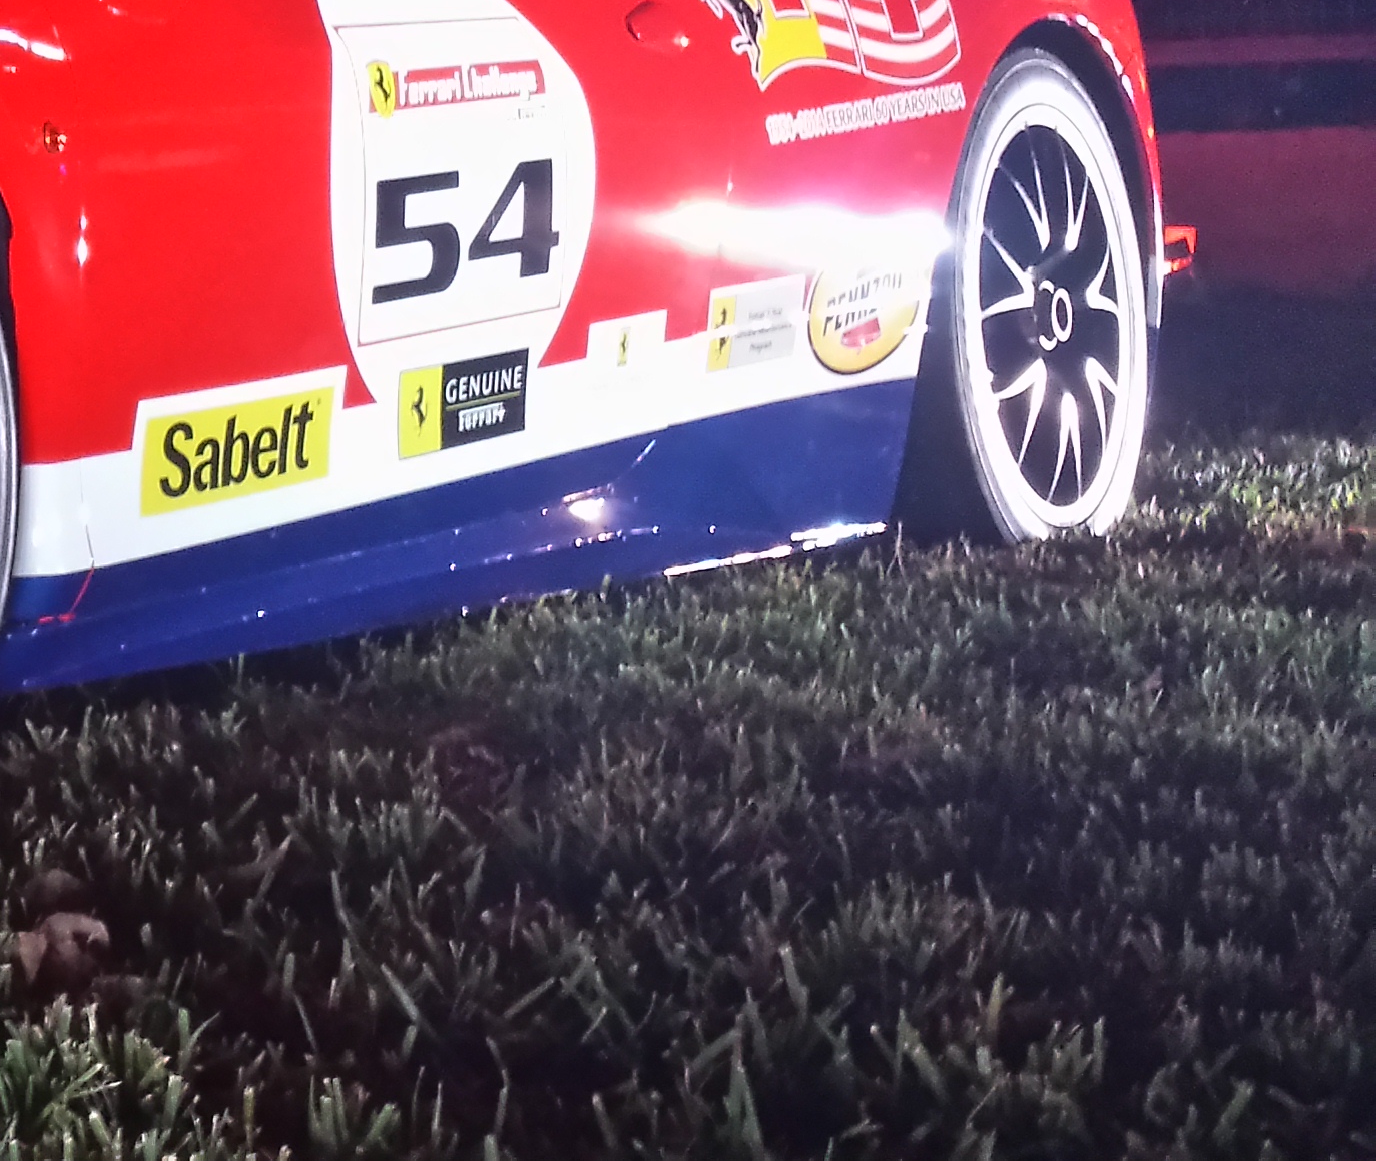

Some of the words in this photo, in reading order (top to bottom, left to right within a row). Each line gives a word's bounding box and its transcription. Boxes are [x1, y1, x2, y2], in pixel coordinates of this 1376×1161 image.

[825, 103, 873, 130] FERRARI
[875, 102, 889, 122] 60
[890, 94, 925, 119] YEARS
[927, 91, 940, 112] IN
[941, 86, 964, 109] USA
[372, 158, 559, 304] 54
[445, 365, 523, 404] GENUINE
[159, 399, 314, 498] Sabelt
